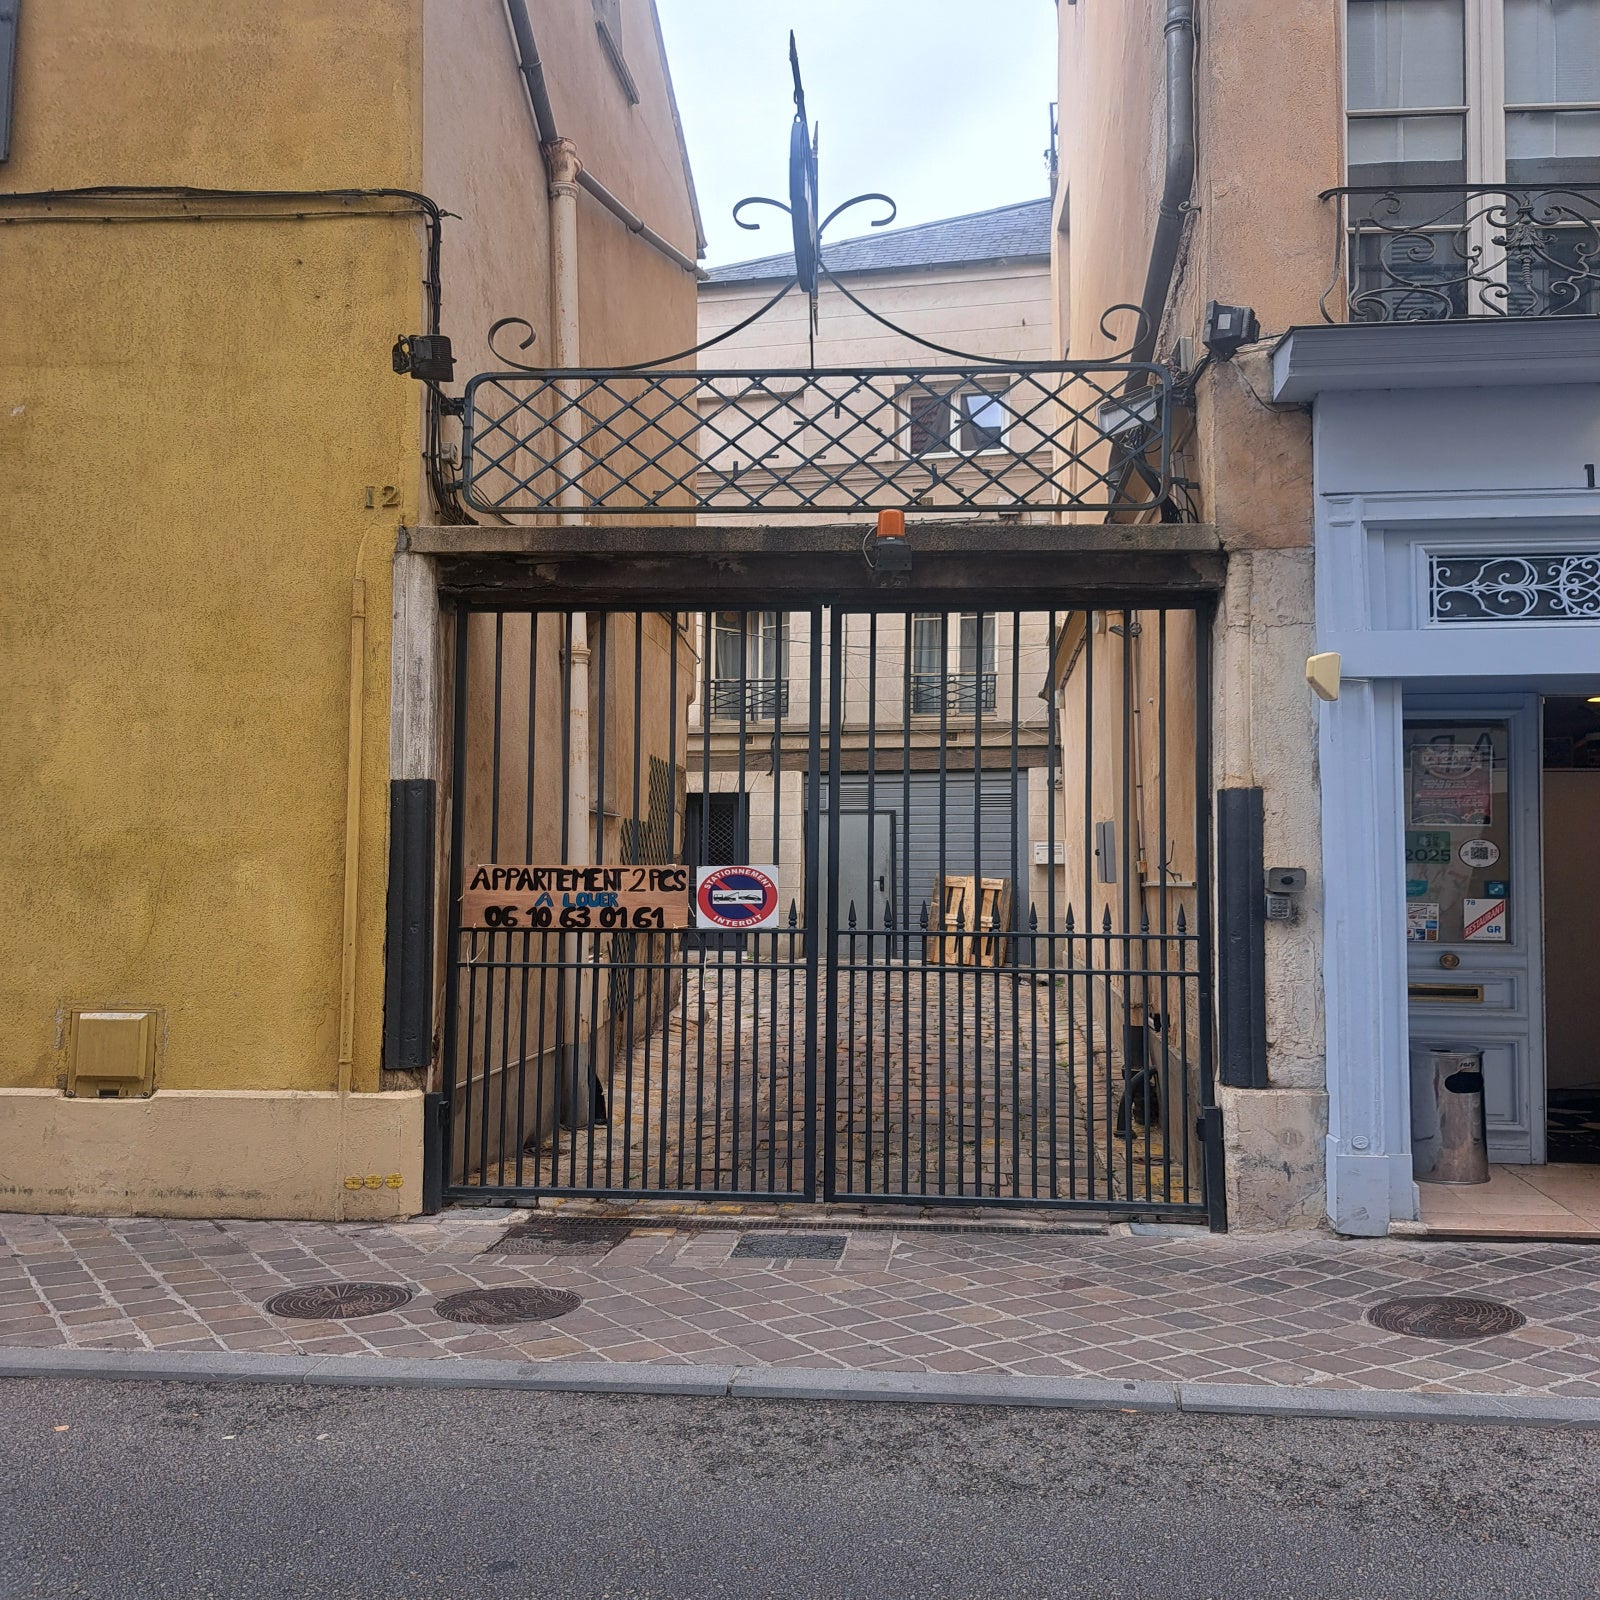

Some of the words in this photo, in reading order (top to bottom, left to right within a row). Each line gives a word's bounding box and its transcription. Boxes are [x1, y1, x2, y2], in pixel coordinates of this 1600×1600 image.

[1584, 463, 1595, 488] 1
[365, 485, 399, 509] 12
[1405, 849, 1451, 862] 2025
[469, 867, 630, 892] APPARTEMENT
[704, 868, 773, 890] STATIONNEMENT
[562, 891, 619, 908] LOUER
[632, 906, 665, 929] 61
[713, 913, 762, 927] INTERDIT
[1465, 902, 1505, 937] RESTAURANT
[1486, 925, 1502, 934] GR
